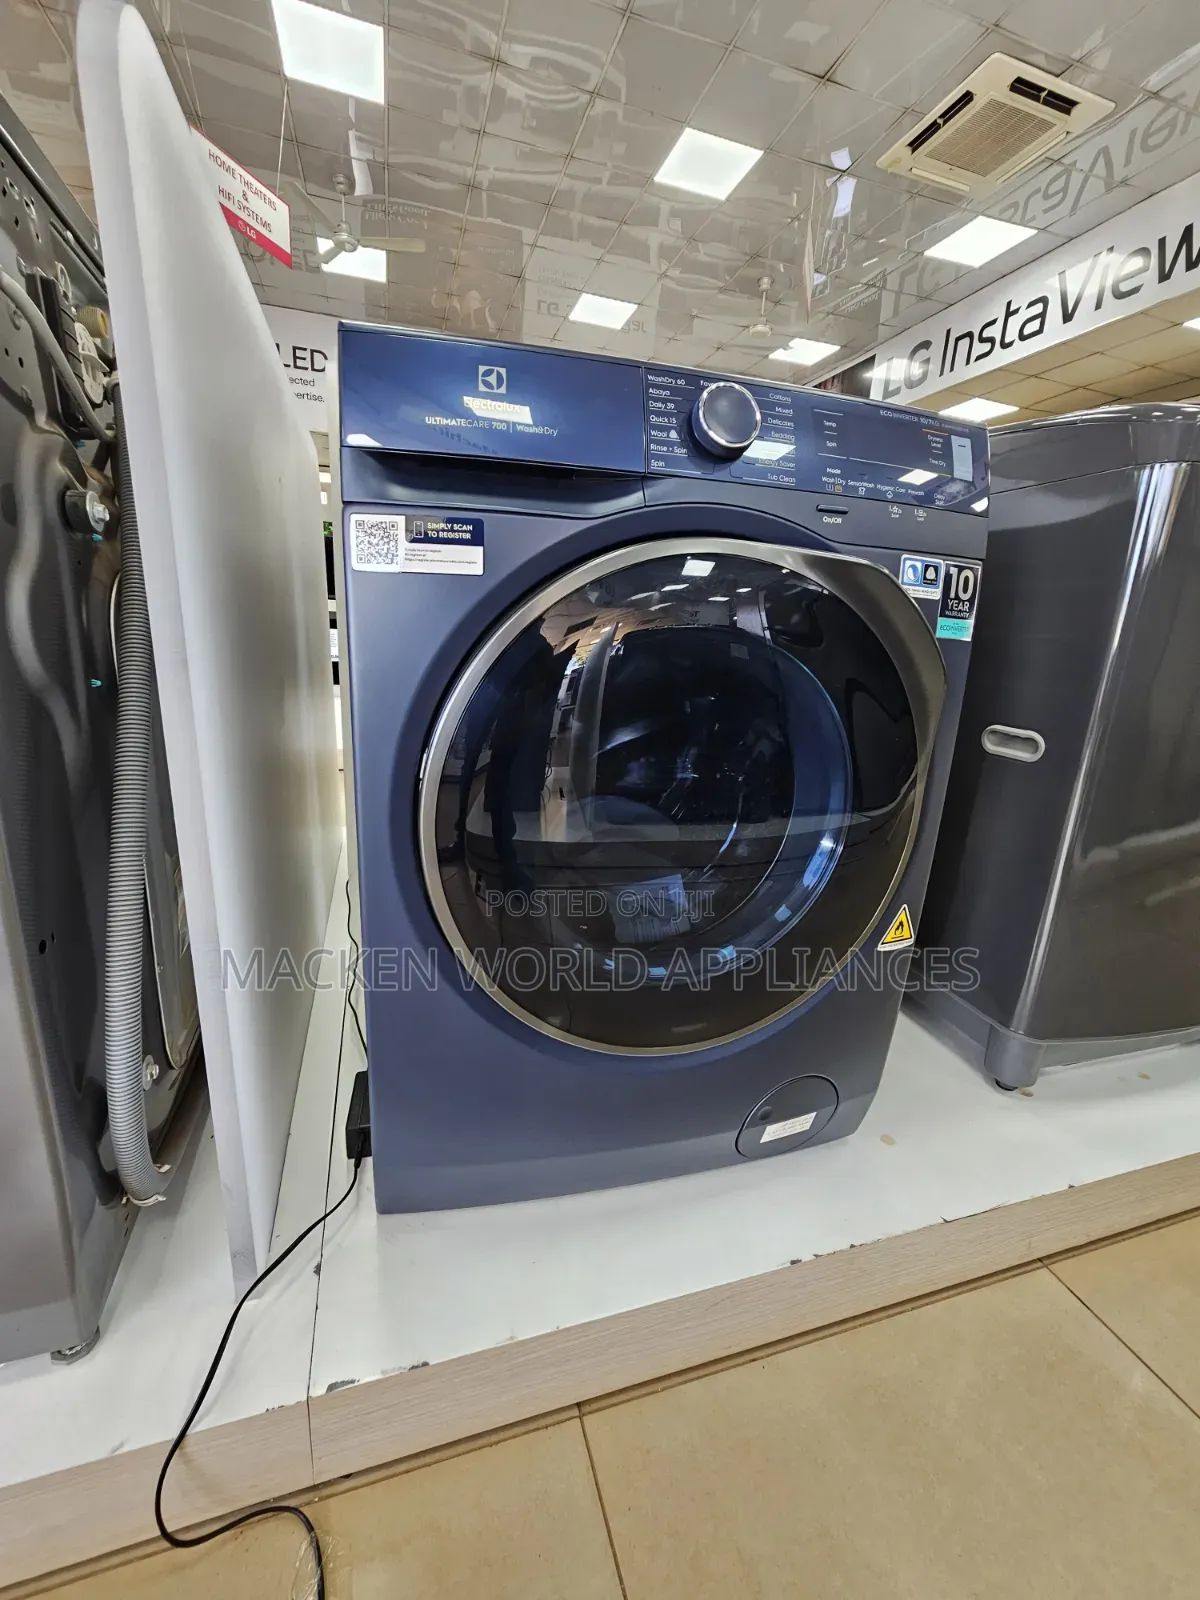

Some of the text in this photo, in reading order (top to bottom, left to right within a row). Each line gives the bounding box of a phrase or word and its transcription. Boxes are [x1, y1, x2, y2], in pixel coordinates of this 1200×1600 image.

[208, 148, 277, 211] HOME THEATERS
[242, 189, 249, 203] &
[218, 185, 272, 233] HIFI SYSTEMS
[247, 226, 257, 240] LG
[882, 339, 933, 401] LG
[287, 373, 316, 387] ected
[647, 374, 676, 386] WashDry
[293, 391, 325, 403] ertise.
[648, 388, 671, 397] Abaya
[769, 393, 792, 402] Cottons
[649, 401, 666, 410] Daily
[775, 407, 794, 415] Mixed
[650, 415, 669, 424] Quick
[767, 417, 795, 428] Delicates
[425, 416, 559, 437] ULTIMATECARE 700 Wash&Dry
[651, 429, 668, 438] Wool
[650, 443, 668, 452] Rinse
[674, 446, 688, 455] Spin
[650, 459, 665, 468] Spin
[826, 467, 842, 475] Mode
[822, 516, 843, 524] On/Off
[427, 522, 473, 531] SIMPLY SCAN
[438, 531, 472, 540] REGISTER
[949, 566, 975, 600] 10
[947, 599, 970, 612] YEAR
